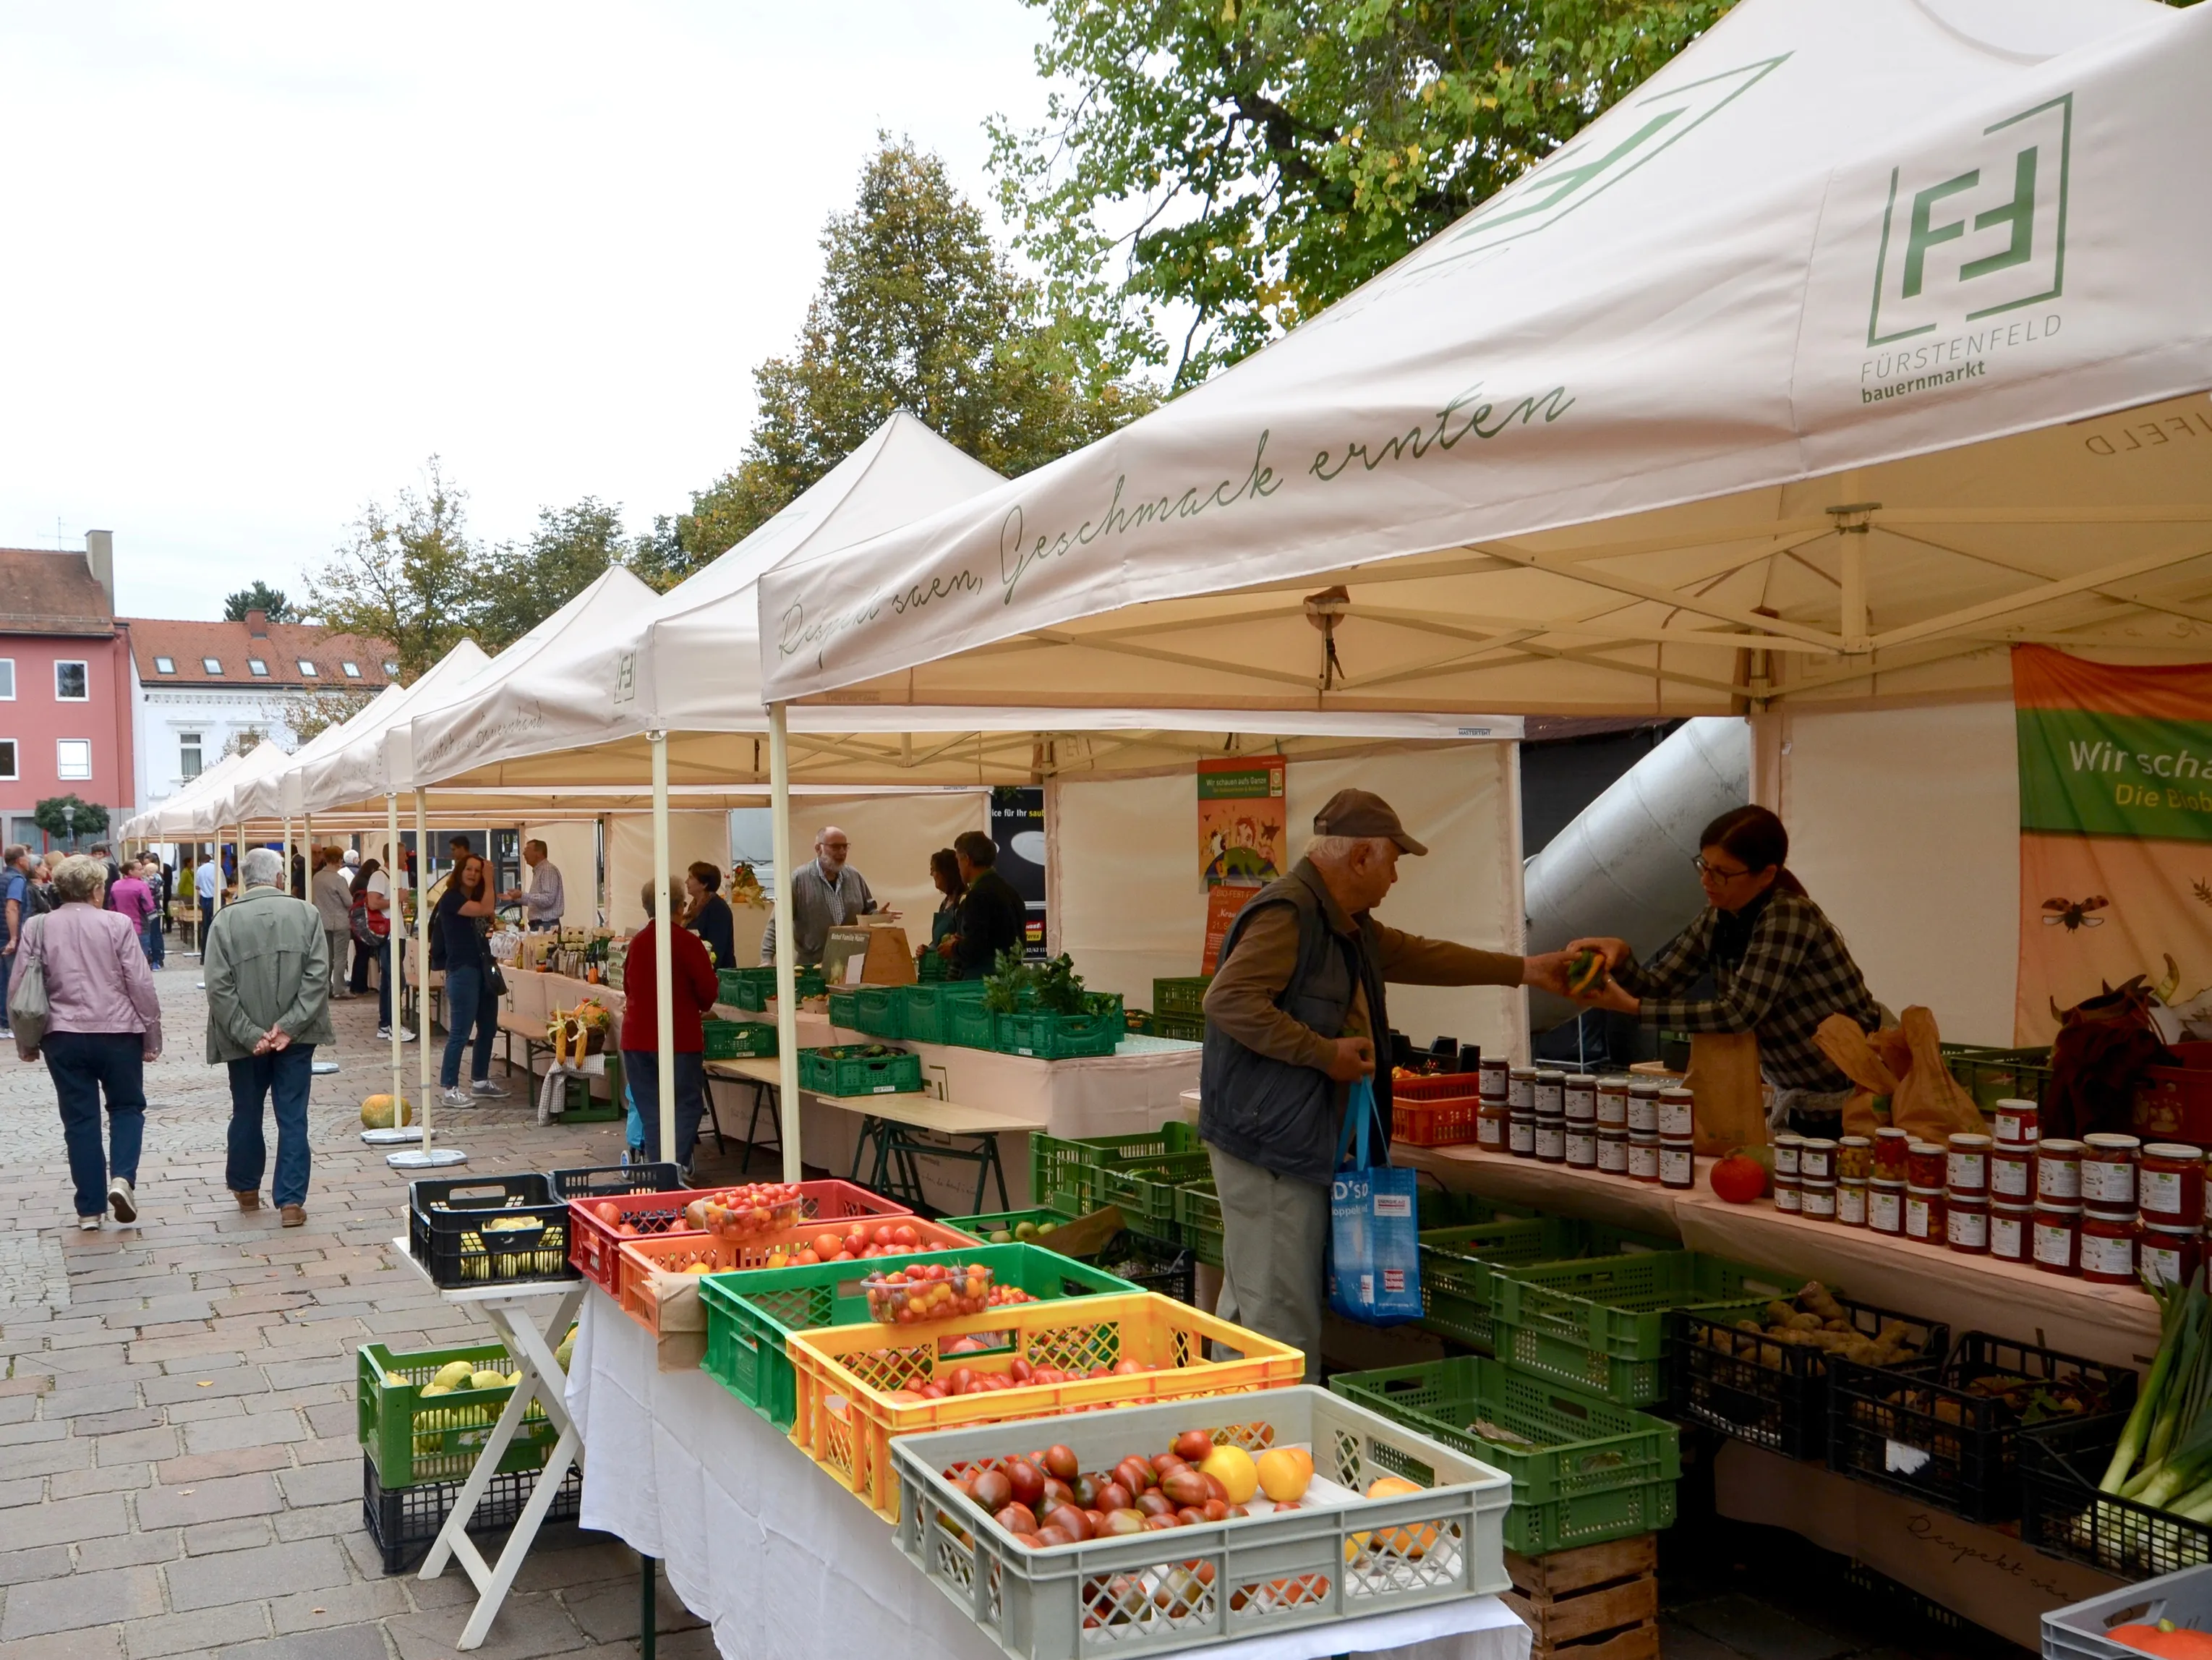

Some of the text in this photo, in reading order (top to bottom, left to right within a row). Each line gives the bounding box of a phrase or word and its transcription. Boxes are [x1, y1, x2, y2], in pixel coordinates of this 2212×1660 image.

[1861, 314, 2063, 384] FÜRSTENFELD
[1861, 360, 1986, 404] bauernmarkt
[1001, 429, 1283, 606] Geschmack
[1309, 381, 1576, 482] ernten
[2068, 740, 2129, 772] Wir
[1206, 776, 1267, 787] Wir schauen aufs Ganze
[2115, 783, 2160, 808] Die
[1004, 808, 1015, 817] für
[1016, 808, 1027, 817] Ihr
[1216, 890, 1244, 899] BIO-FEST
[1906, 1513, 2025, 1577] Respekt
